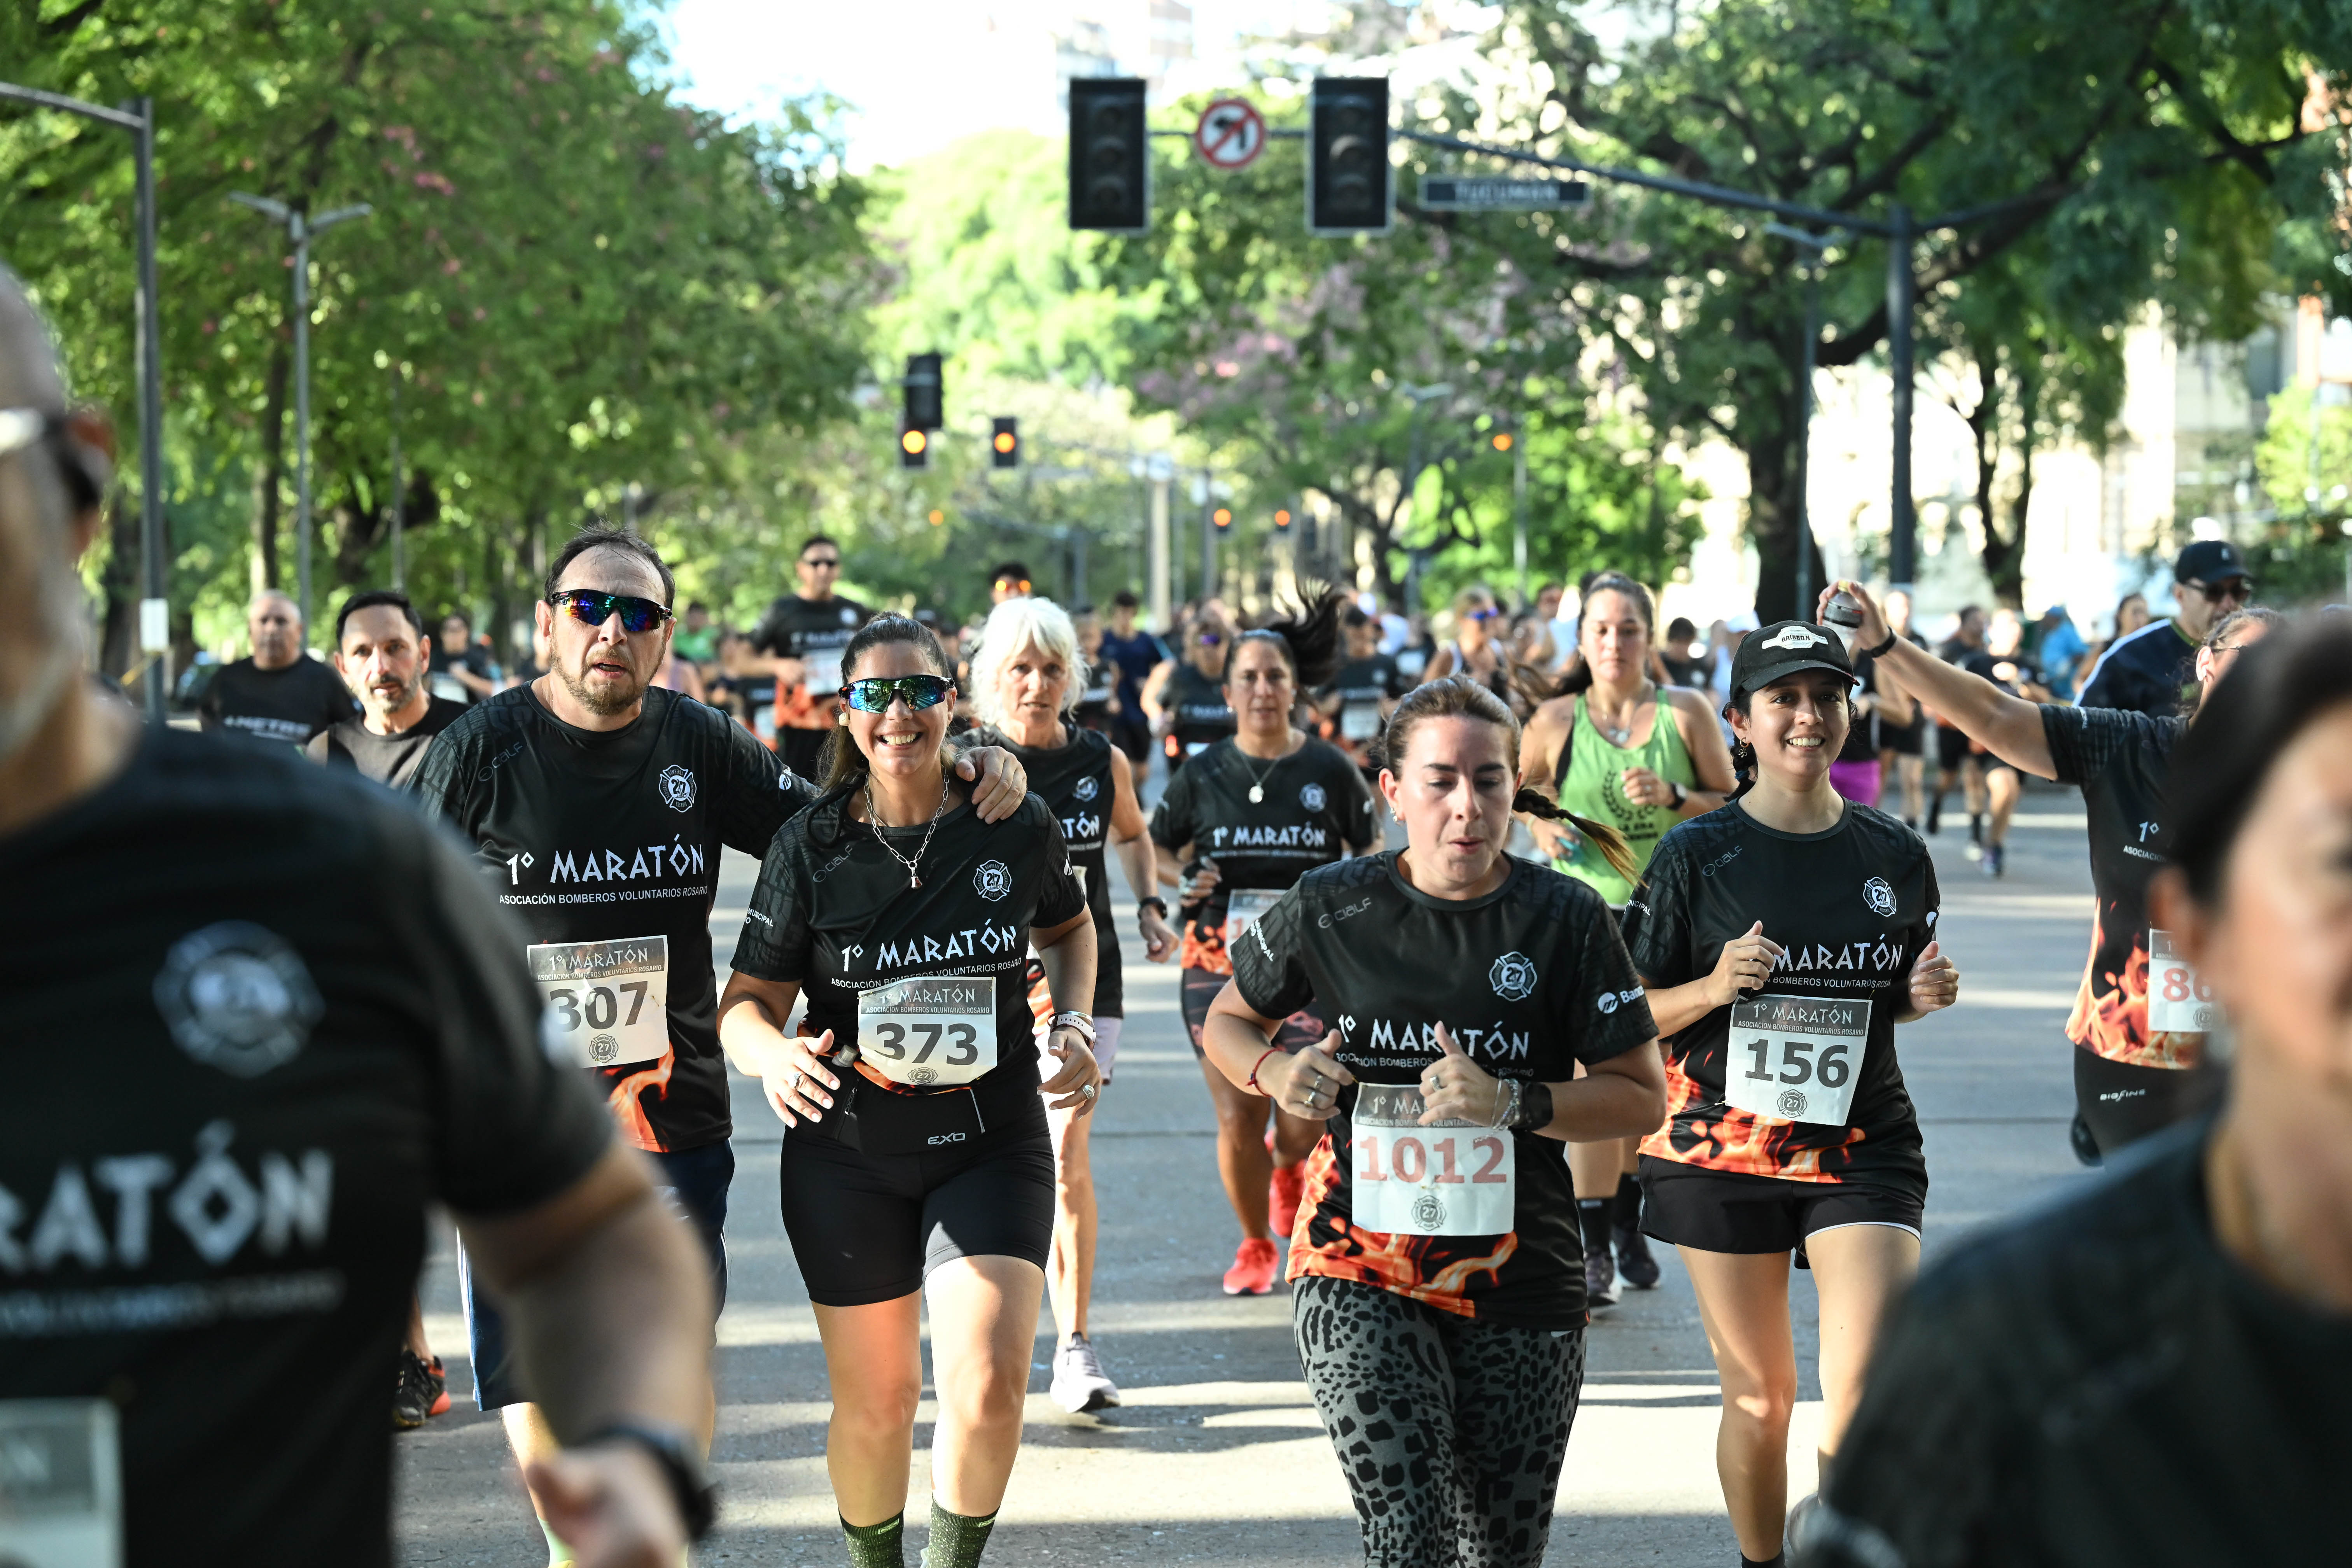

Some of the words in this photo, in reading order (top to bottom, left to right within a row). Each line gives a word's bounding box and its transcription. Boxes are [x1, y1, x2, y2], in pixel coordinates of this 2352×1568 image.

[1232, 821, 1326, 847] MARATÓN
[550, 833, 704, 884] MARATÓN
[500, 892, 556, 905] ASOCIACIÓN
[559, 892, 616, 904] BOMBEROS
[618, 888, 681, 901] VOLUNTARIOS
[682, 885, 708, 897] ROSARIO
[747, 907, 774, 927] MUNICIPAL
[569, 944, 648, 970] MARATÓN
[876, 918, 1017, 971] MARATÓN
[1769, 933, 1902, 973] MARATÓN
[571, 971, 602, 980] BOMBEROS
[602, 967, 637, 977] VOLUNTARIOS
[831, 977, 881, 989] ASOCIACIÓN
[936, 964, 996, 977] VOLUNTARIOS
[998, 957, 1022, 971] ROSARIO
[1773, 976, 1821, 986] BOMBEROS
[1824, 978, 1876, 989] VOLUNTAROS
[550, 981, 648, 1032] 307
[898, 984, 975, 1004] MARATÓN
[1772, 1004, 1852, 1025] MARATÓN
[1773, 1024, 1803, 1032] BOMBEROS
[1804, 1026, 1841, 1035] VOLUNTARIOS
[874, 1023, 978, 1066] 373
[1745, 1038, 1850, 1088] 156
[928, 1132, 966, 1145] EXO
[1360, 1136, 1507, 1184] 1012
